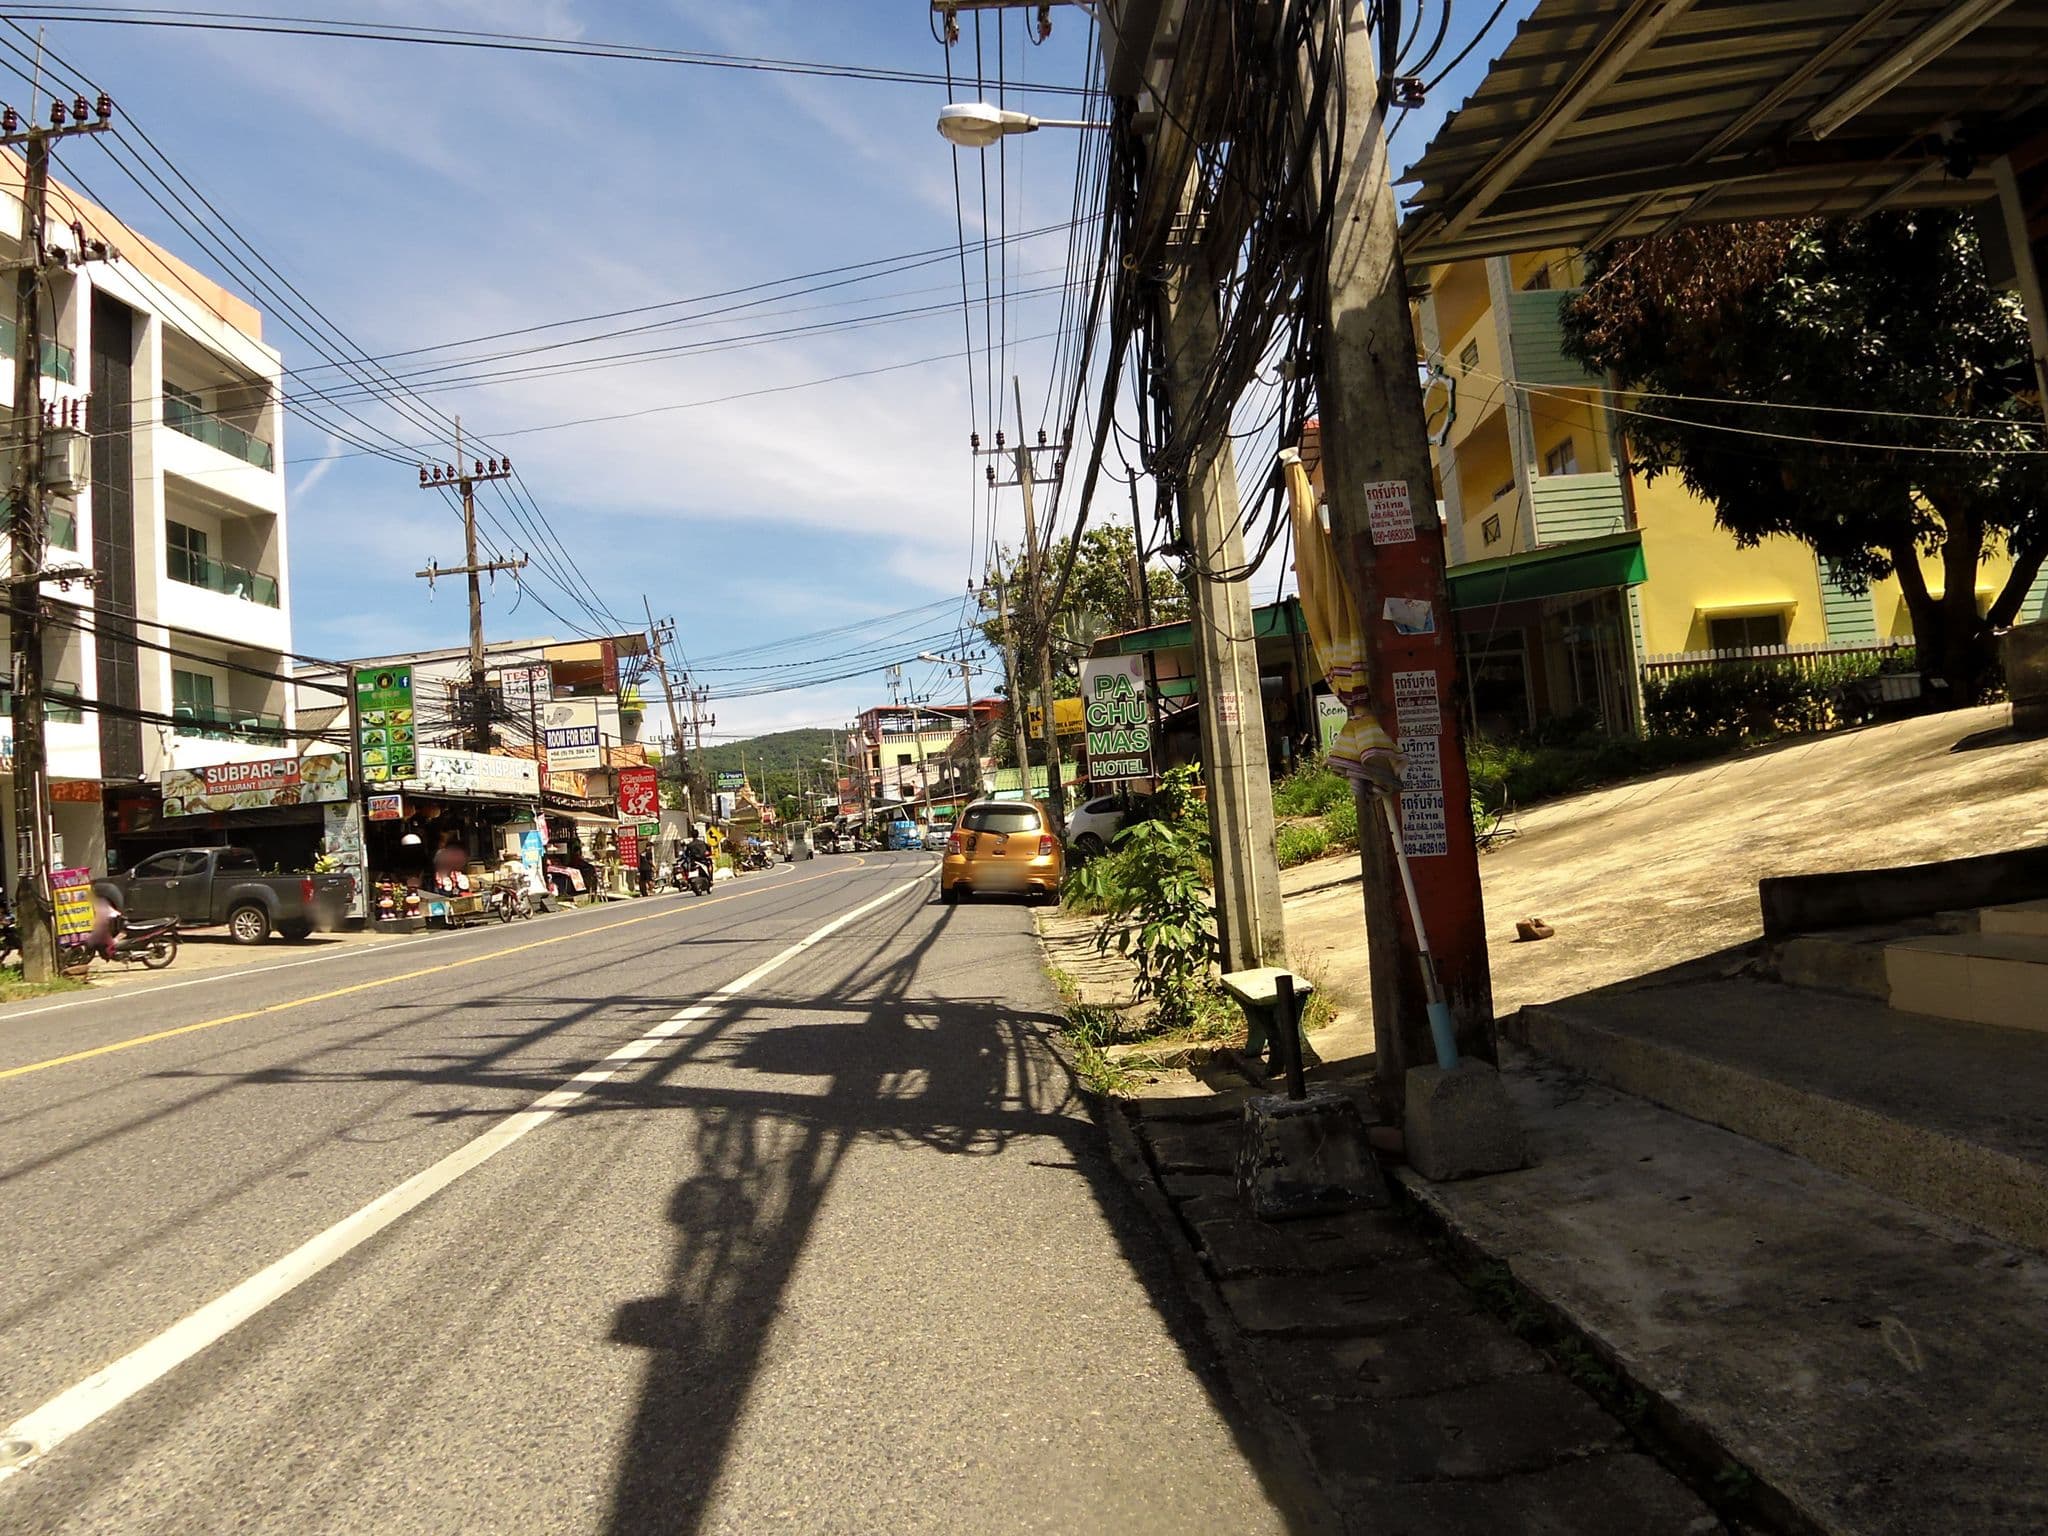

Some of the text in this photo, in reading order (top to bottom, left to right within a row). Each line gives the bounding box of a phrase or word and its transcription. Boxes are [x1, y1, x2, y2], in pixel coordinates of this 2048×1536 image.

[1366, 483, 1407, 500] รถรับจ้าง
[1094, 674, 1135, 700] PA
[1395, 673, 1436, 689] รถรับจ้าง
[1087, 701, 1147, 727] CHU
[547, 727, 596, 748] ROOM FOR RENT
[1088, 728, 1150, 755] MAS
[1402, 738, 1435, 752] บริการ
[1092, 760, 1149, 776] HOTEL
[210, 782, 257, 794] RESTAURANT
[1401, 793, 1443, 810] รถรับจ้าง
